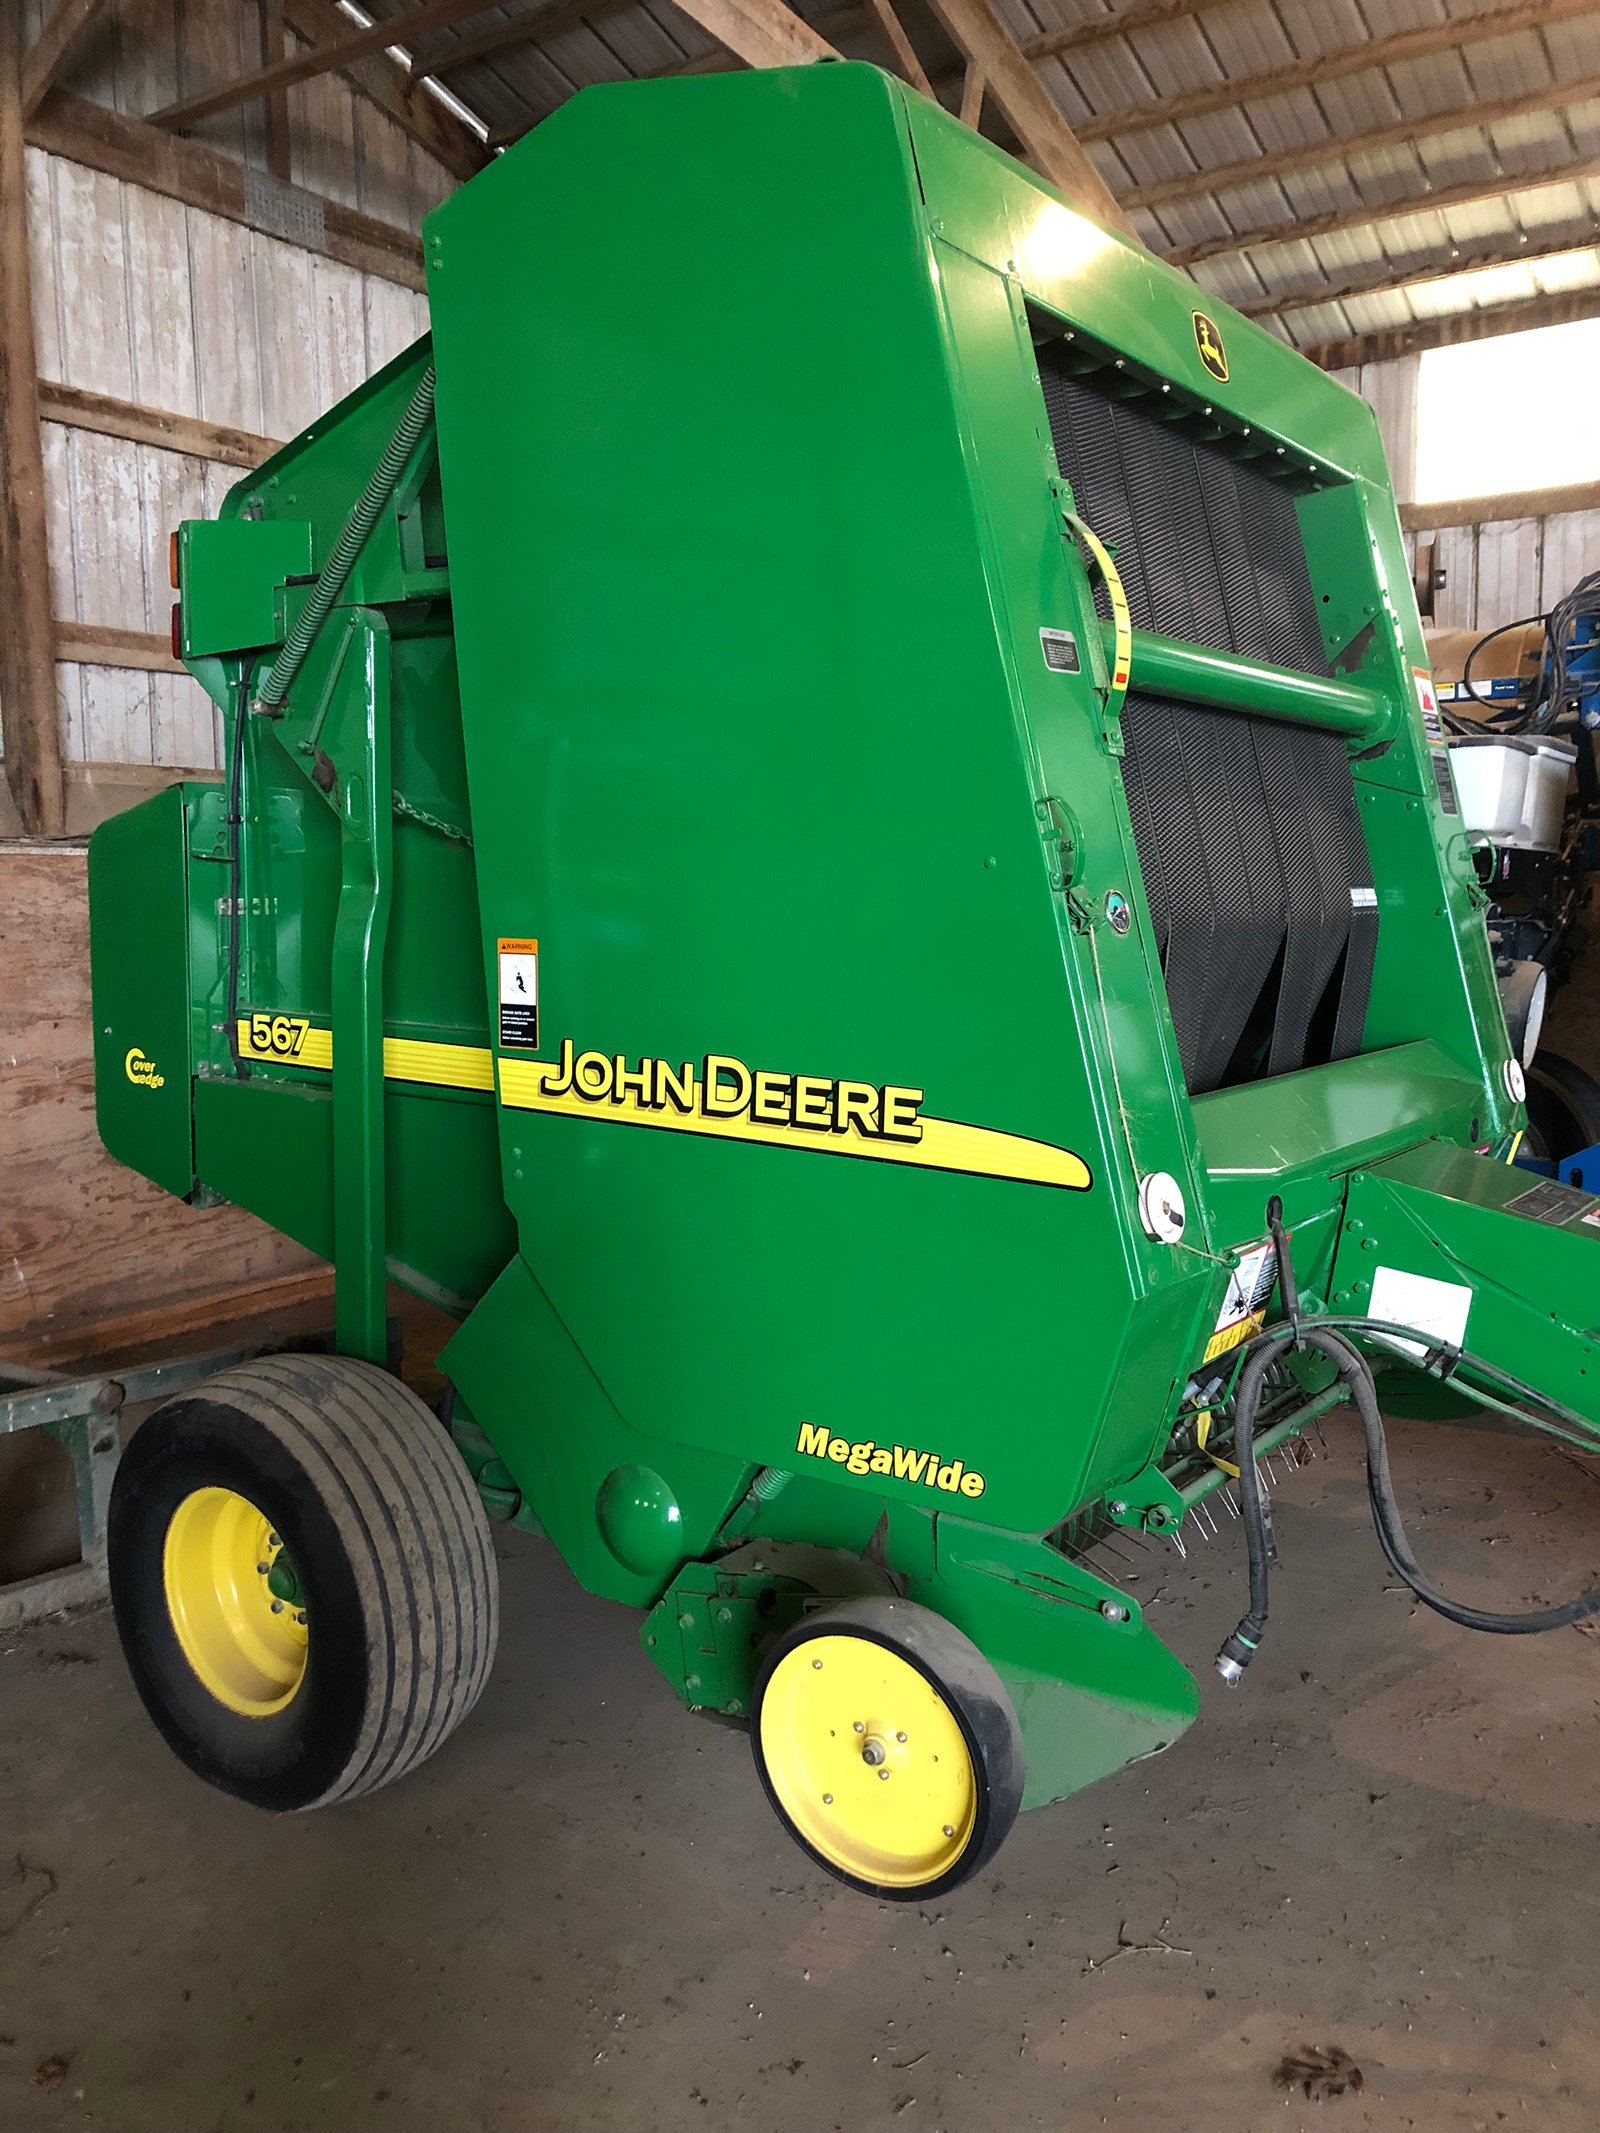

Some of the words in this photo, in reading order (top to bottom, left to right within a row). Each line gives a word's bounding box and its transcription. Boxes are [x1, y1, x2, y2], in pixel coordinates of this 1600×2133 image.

[251, 1013, 310, 1056] 567
[540, 1038, 695, 1112] JOHN
[702, 1054, 924, 1144] DEERE
[796, 1421, 986, 1498] MegaWide
